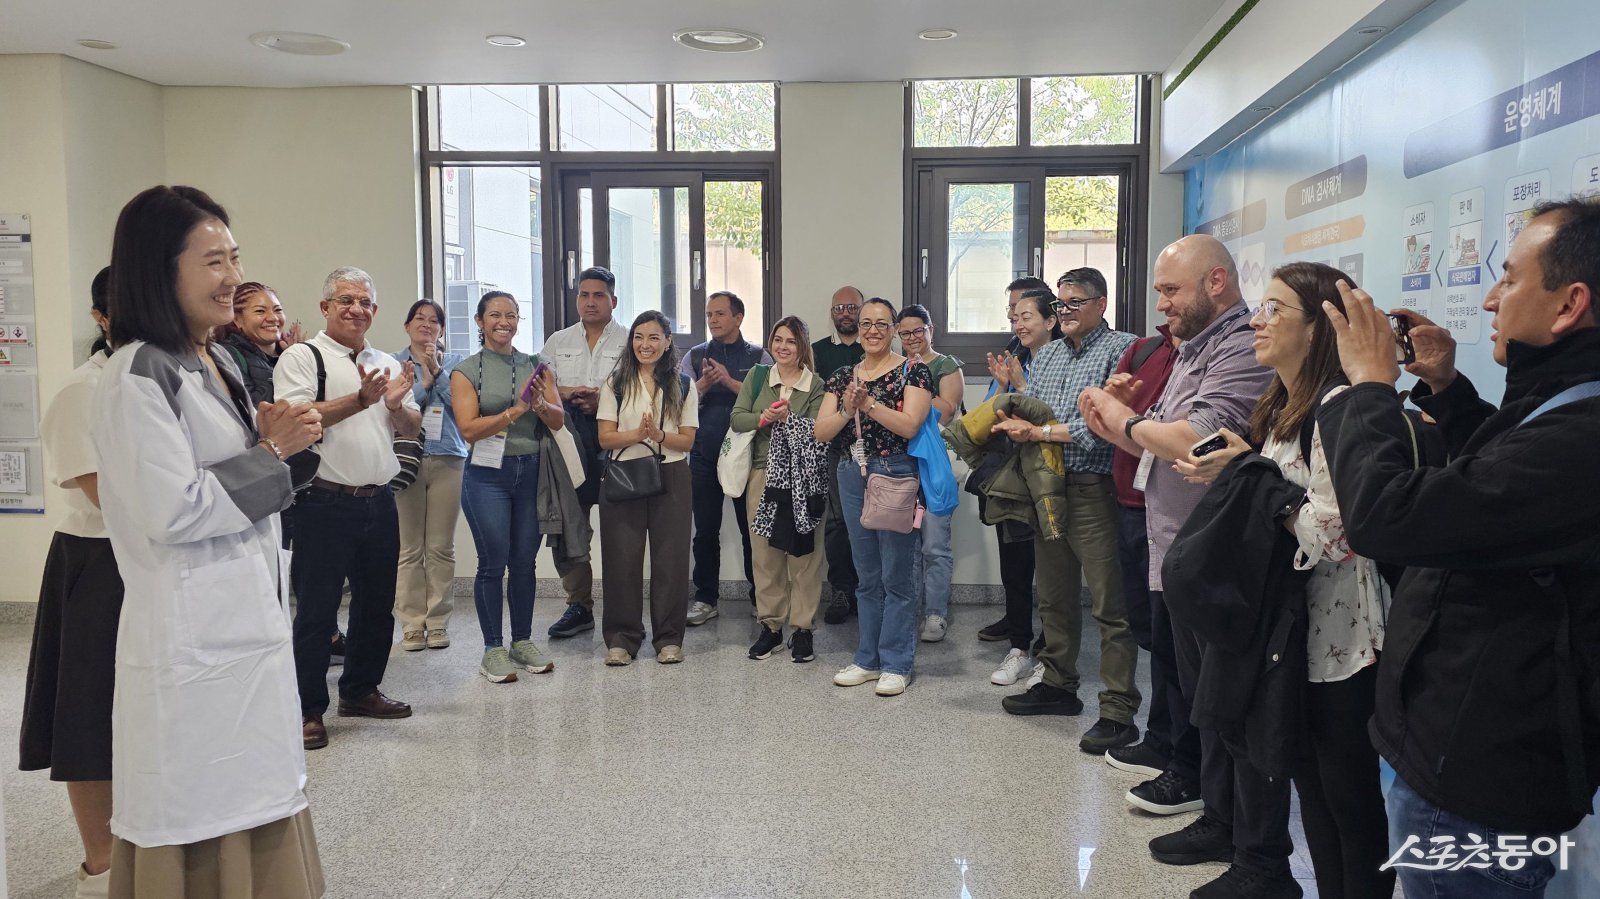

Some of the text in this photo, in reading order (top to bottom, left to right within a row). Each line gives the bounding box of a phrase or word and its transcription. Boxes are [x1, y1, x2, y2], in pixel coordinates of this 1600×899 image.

[1503, 81, 1562, 133] 운영체계
[446, 185, 454, 195] LG
[1301, 173, 1342, 206] DNA 검사체계
[1512, 181, 1541, 201] 포장처리
[1410, 211, 1426, 226] 소비자
